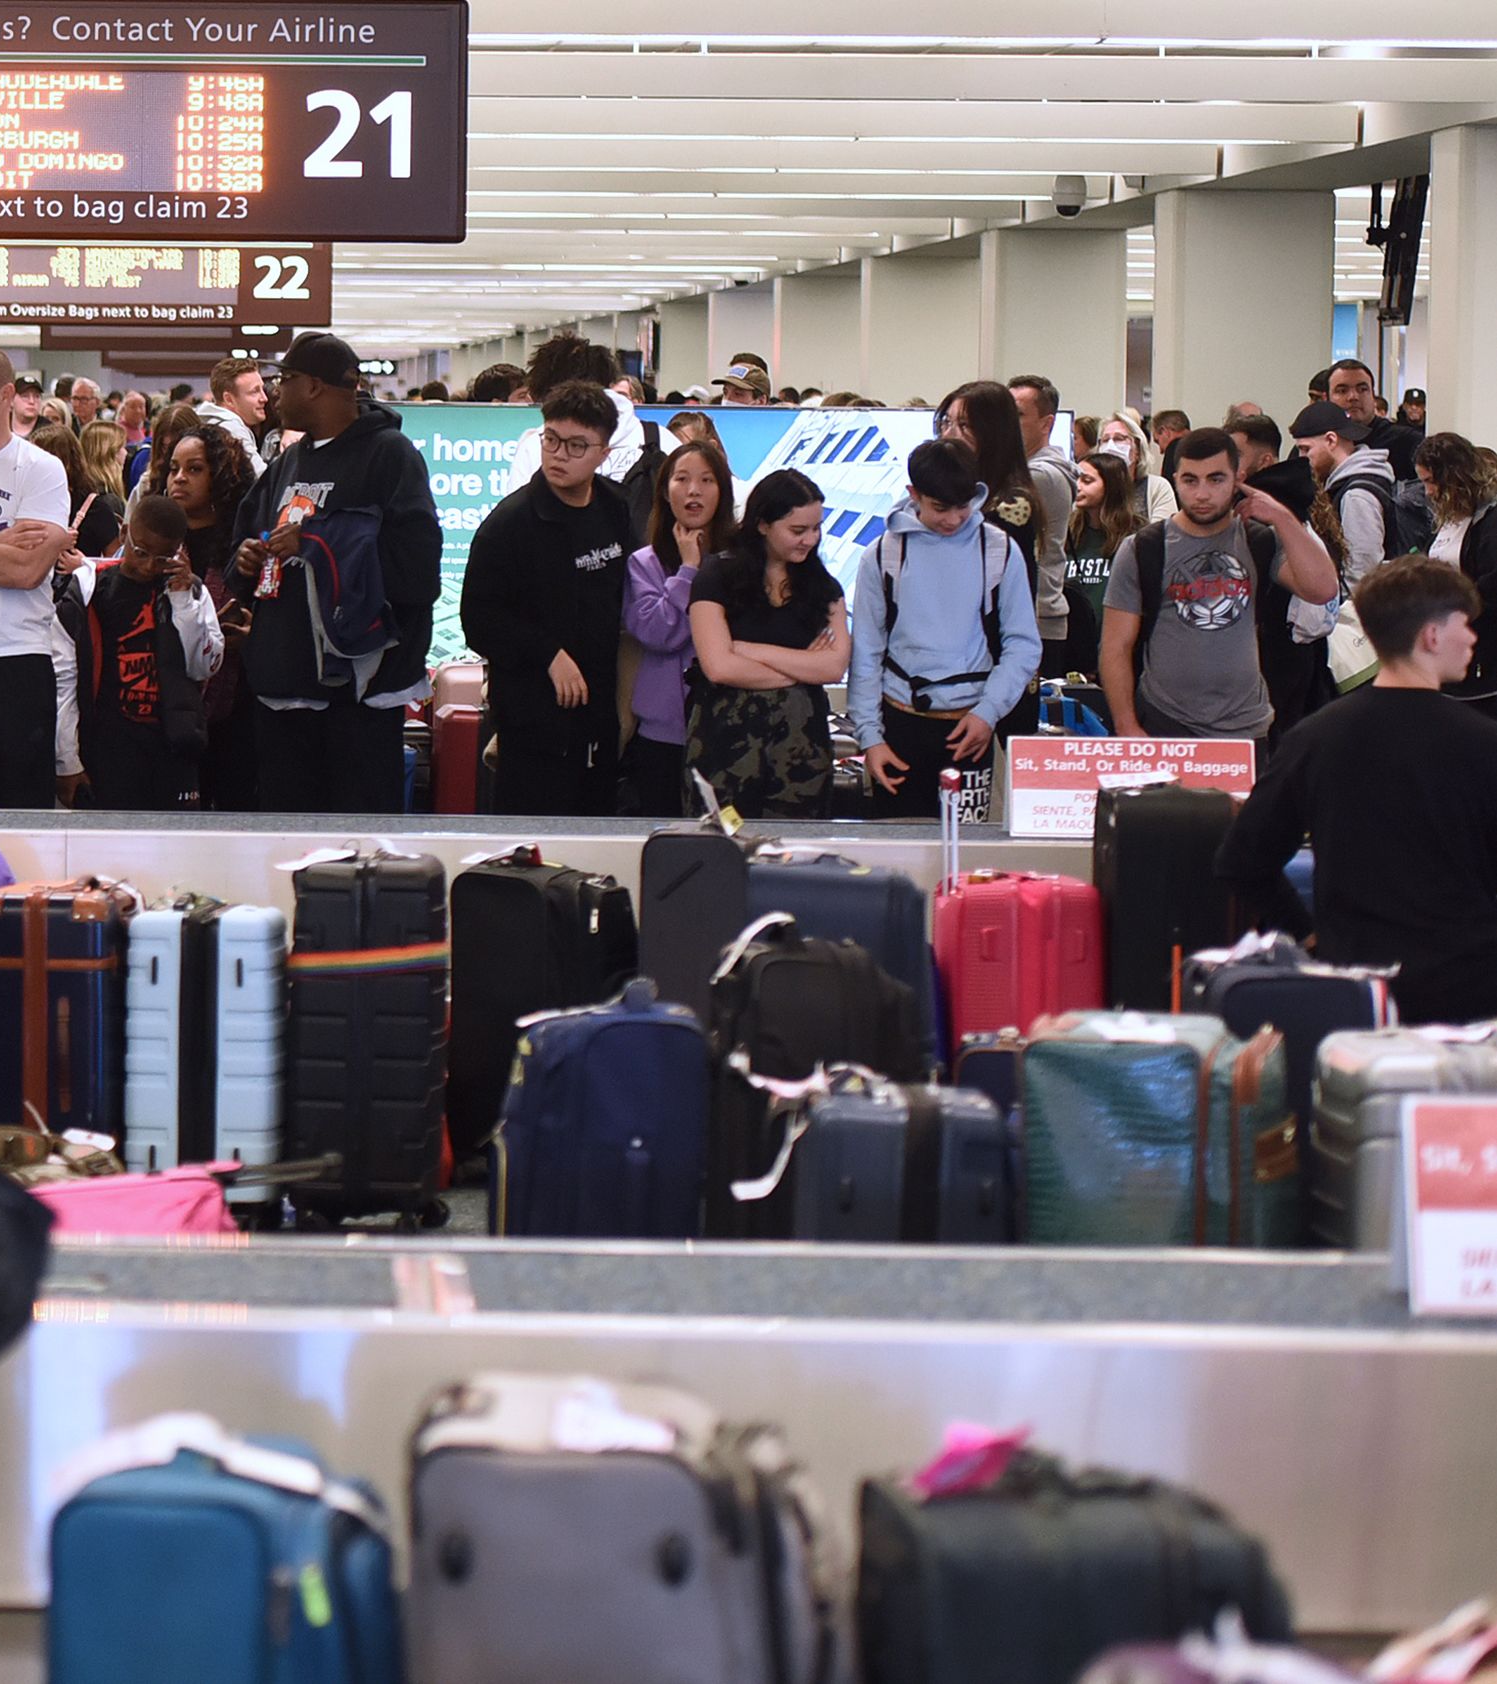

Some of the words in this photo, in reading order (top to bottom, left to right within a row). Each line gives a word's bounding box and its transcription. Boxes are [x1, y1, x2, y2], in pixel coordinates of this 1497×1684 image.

[52, 16, 174, 42] Contact
[185, 17, 258, 43] Your
[268, 17, 376, 43] Airline
[187, 92, 265, 112] 9:48A
[176, 114, 265, 132] 10:24A
[176, 132, 265, 152] 10:25A
[304, 89, 412, 178] 21
[17, 153, 125, 171] DOMINGO
[176, 153, 265, 172] 10:32A
[176, 172, 265, 191] 10:32A
[34, 197, 63, 218] to
[73, 194, 125, 224] bag
[134, 195, 206, 219] claim
[216, 196, 249, 219] 23
[253, 255, 310, 299] 22
[10, 304, 66, 317] Oversize
[68, 304, 99, 320] Bags
[102, 306, 131, 318] next
[134, 307, 149, 318] to
[152, 305, 177, 320] bag
[179, 306, 214, 318] claim
[217, 306, 234, 319] 23
[429, 473, 483, 496] ore
[1064, 742, 1123, 757] PLEASE
[1129, 743, 1156, 757] DO
[1161, 743, 1198, 758] NOT
[1015, 757, 1039, 772] Sit,
[1044, 758, 1091, 773] Stand,
[1096, 759, 1114, 773] Or
[1119, 759, 1152, 773] Ride
[1156, 761, 1179, 774] On
[1184, 761, 1248, 776] Baggage
[962, 768, 992, 789] THE
[1032, 806, 1077, 817] SIENTE,
[1033, 819, 1049, 829] LA
